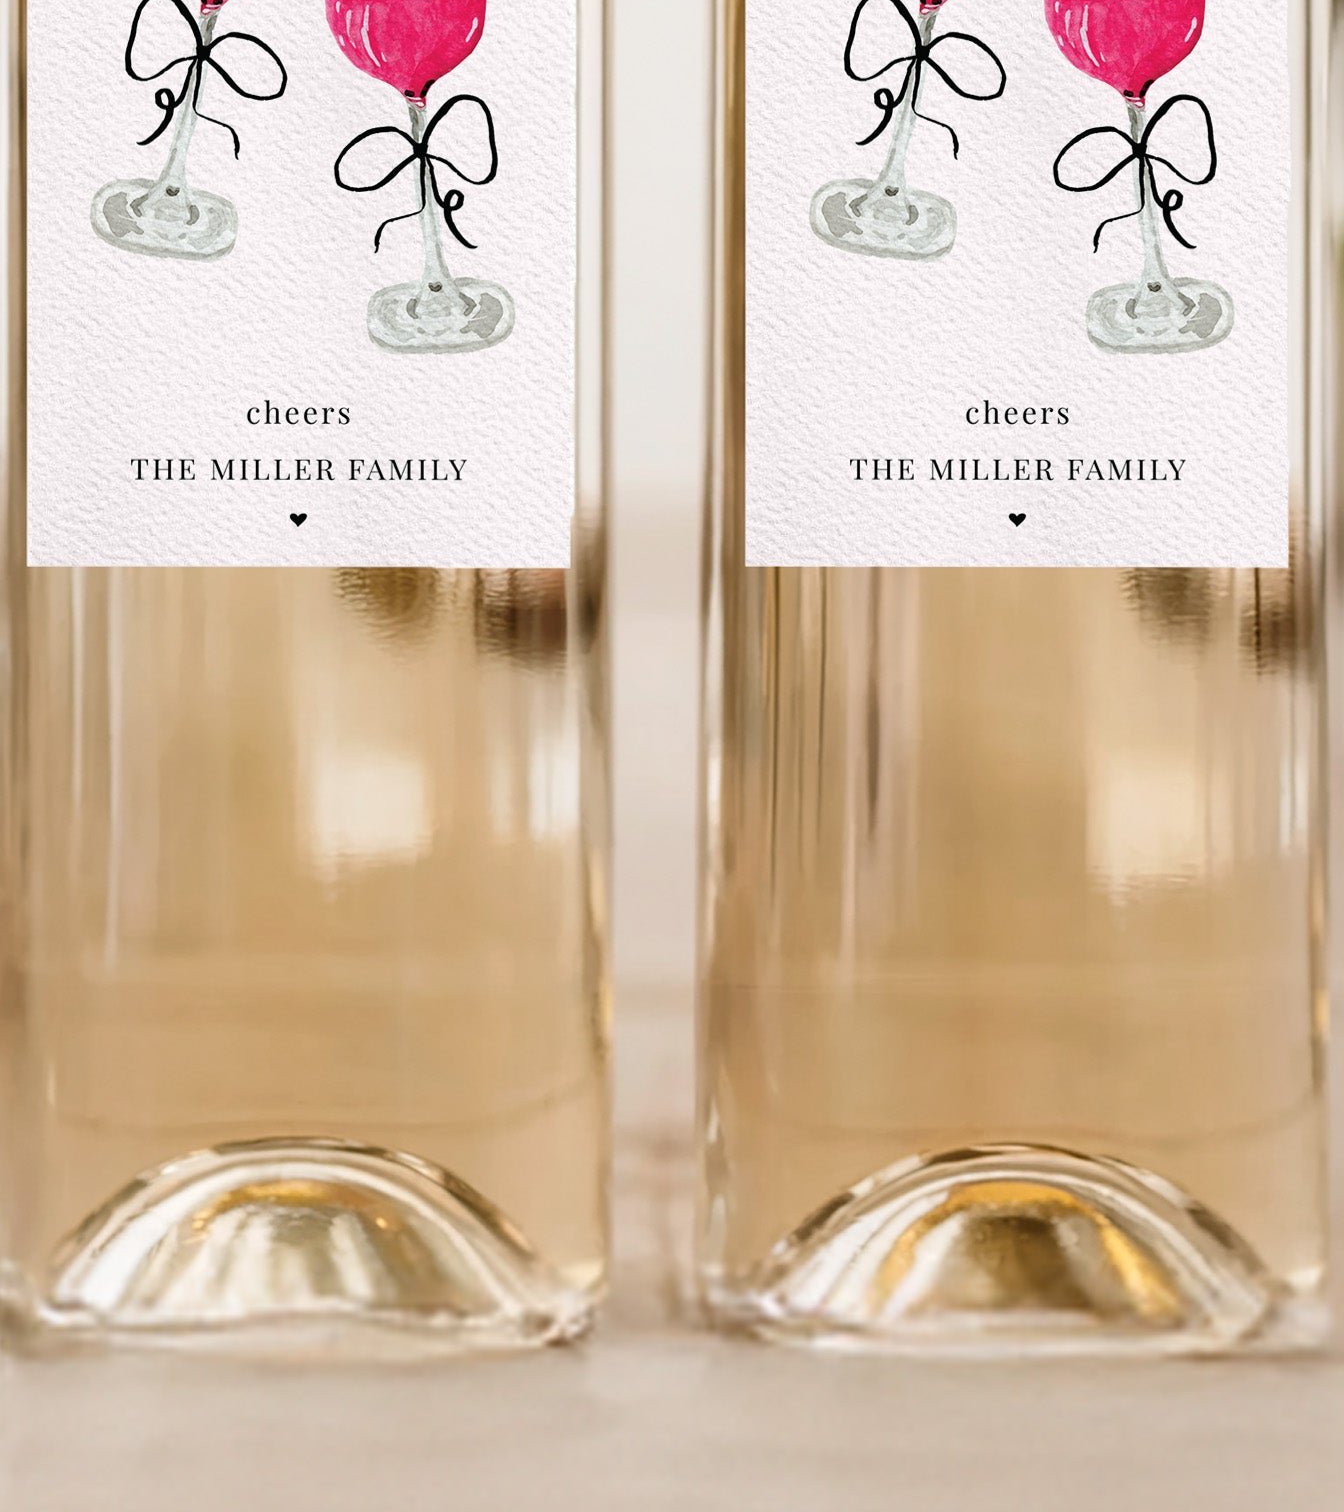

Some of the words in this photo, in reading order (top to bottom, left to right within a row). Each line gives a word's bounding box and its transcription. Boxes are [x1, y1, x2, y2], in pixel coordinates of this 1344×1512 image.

[246, 399, 351, 426] cheers
[965, 399, 1070, 426] cheers
[130, 458, 196, 481] THE
[210, 458, 336, 481] MILLER
[348, 458, 468, 481] FAMILY
[849, 458, 915, 481] THE
[929, 458, 1055, 481] MILLER
[1067, 458, 1186, 481] FAMILY
